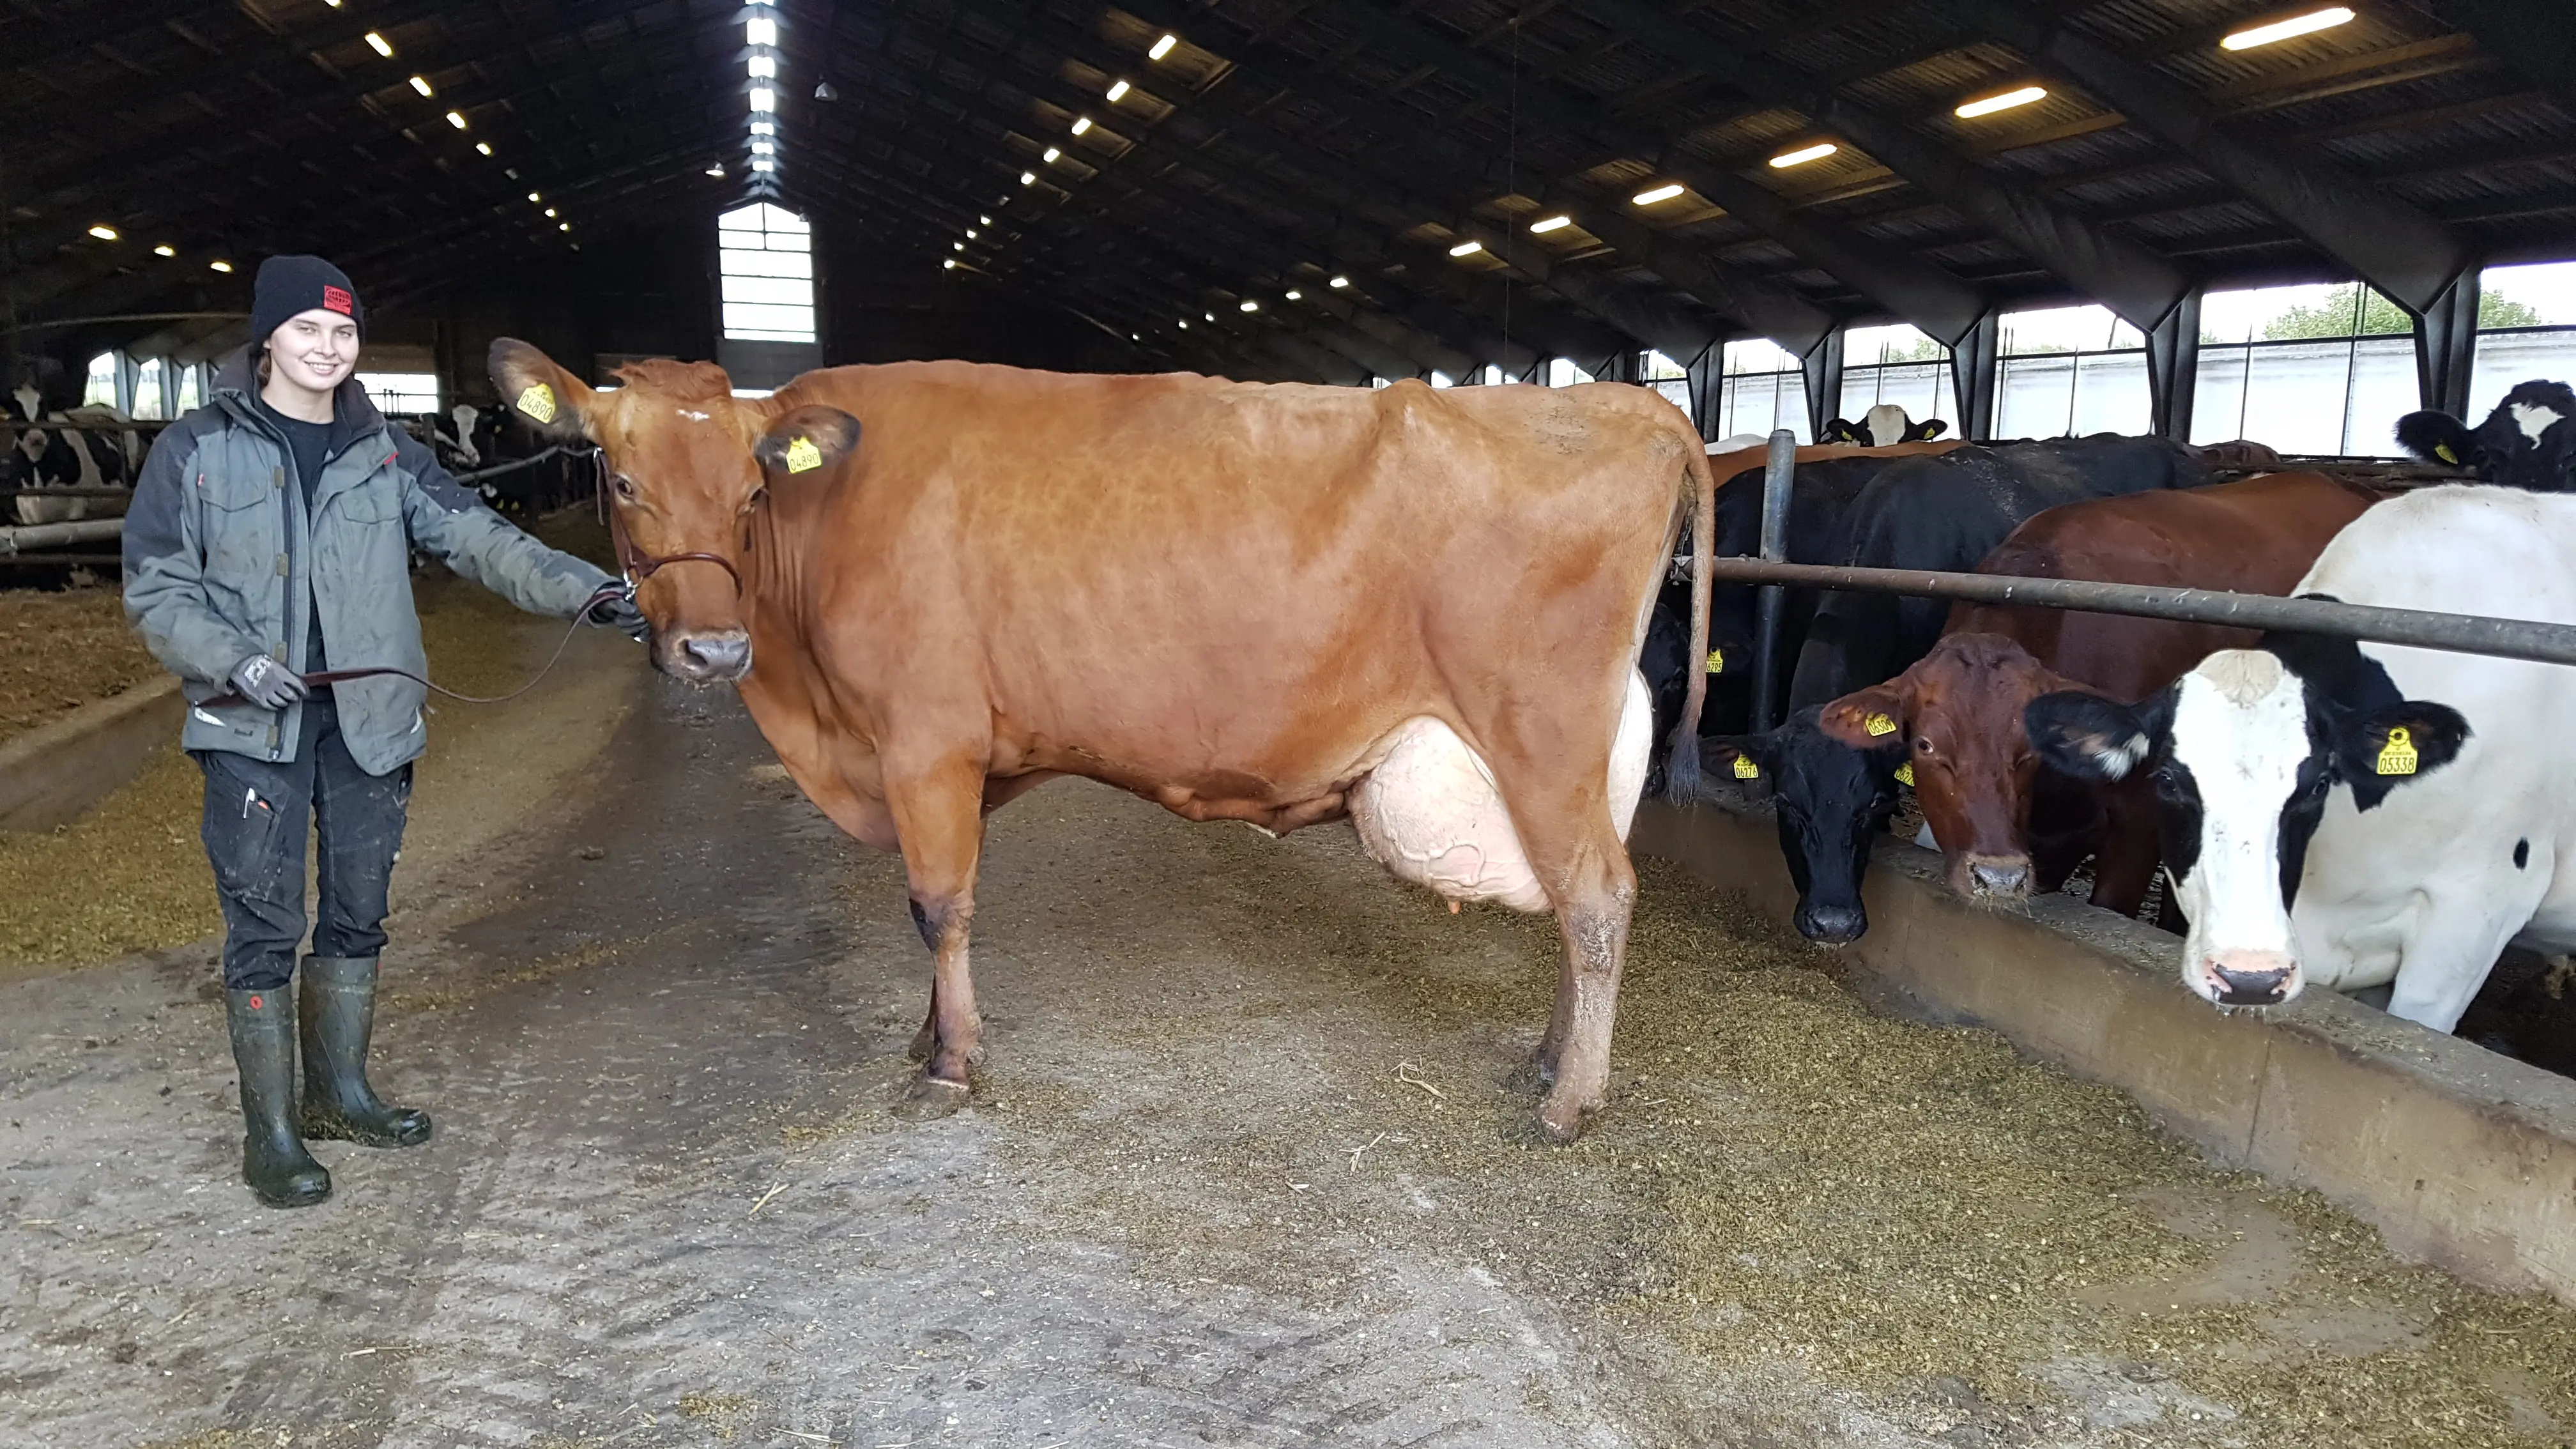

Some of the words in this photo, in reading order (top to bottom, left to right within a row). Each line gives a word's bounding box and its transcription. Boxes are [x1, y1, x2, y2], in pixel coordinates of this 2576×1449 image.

[519, 394, 553, 420] 04890
[790, 453, 819, 471] 04890
[1736, 767, 1758, 778] 06276
[2379, 757, 2415, 772] 05338
